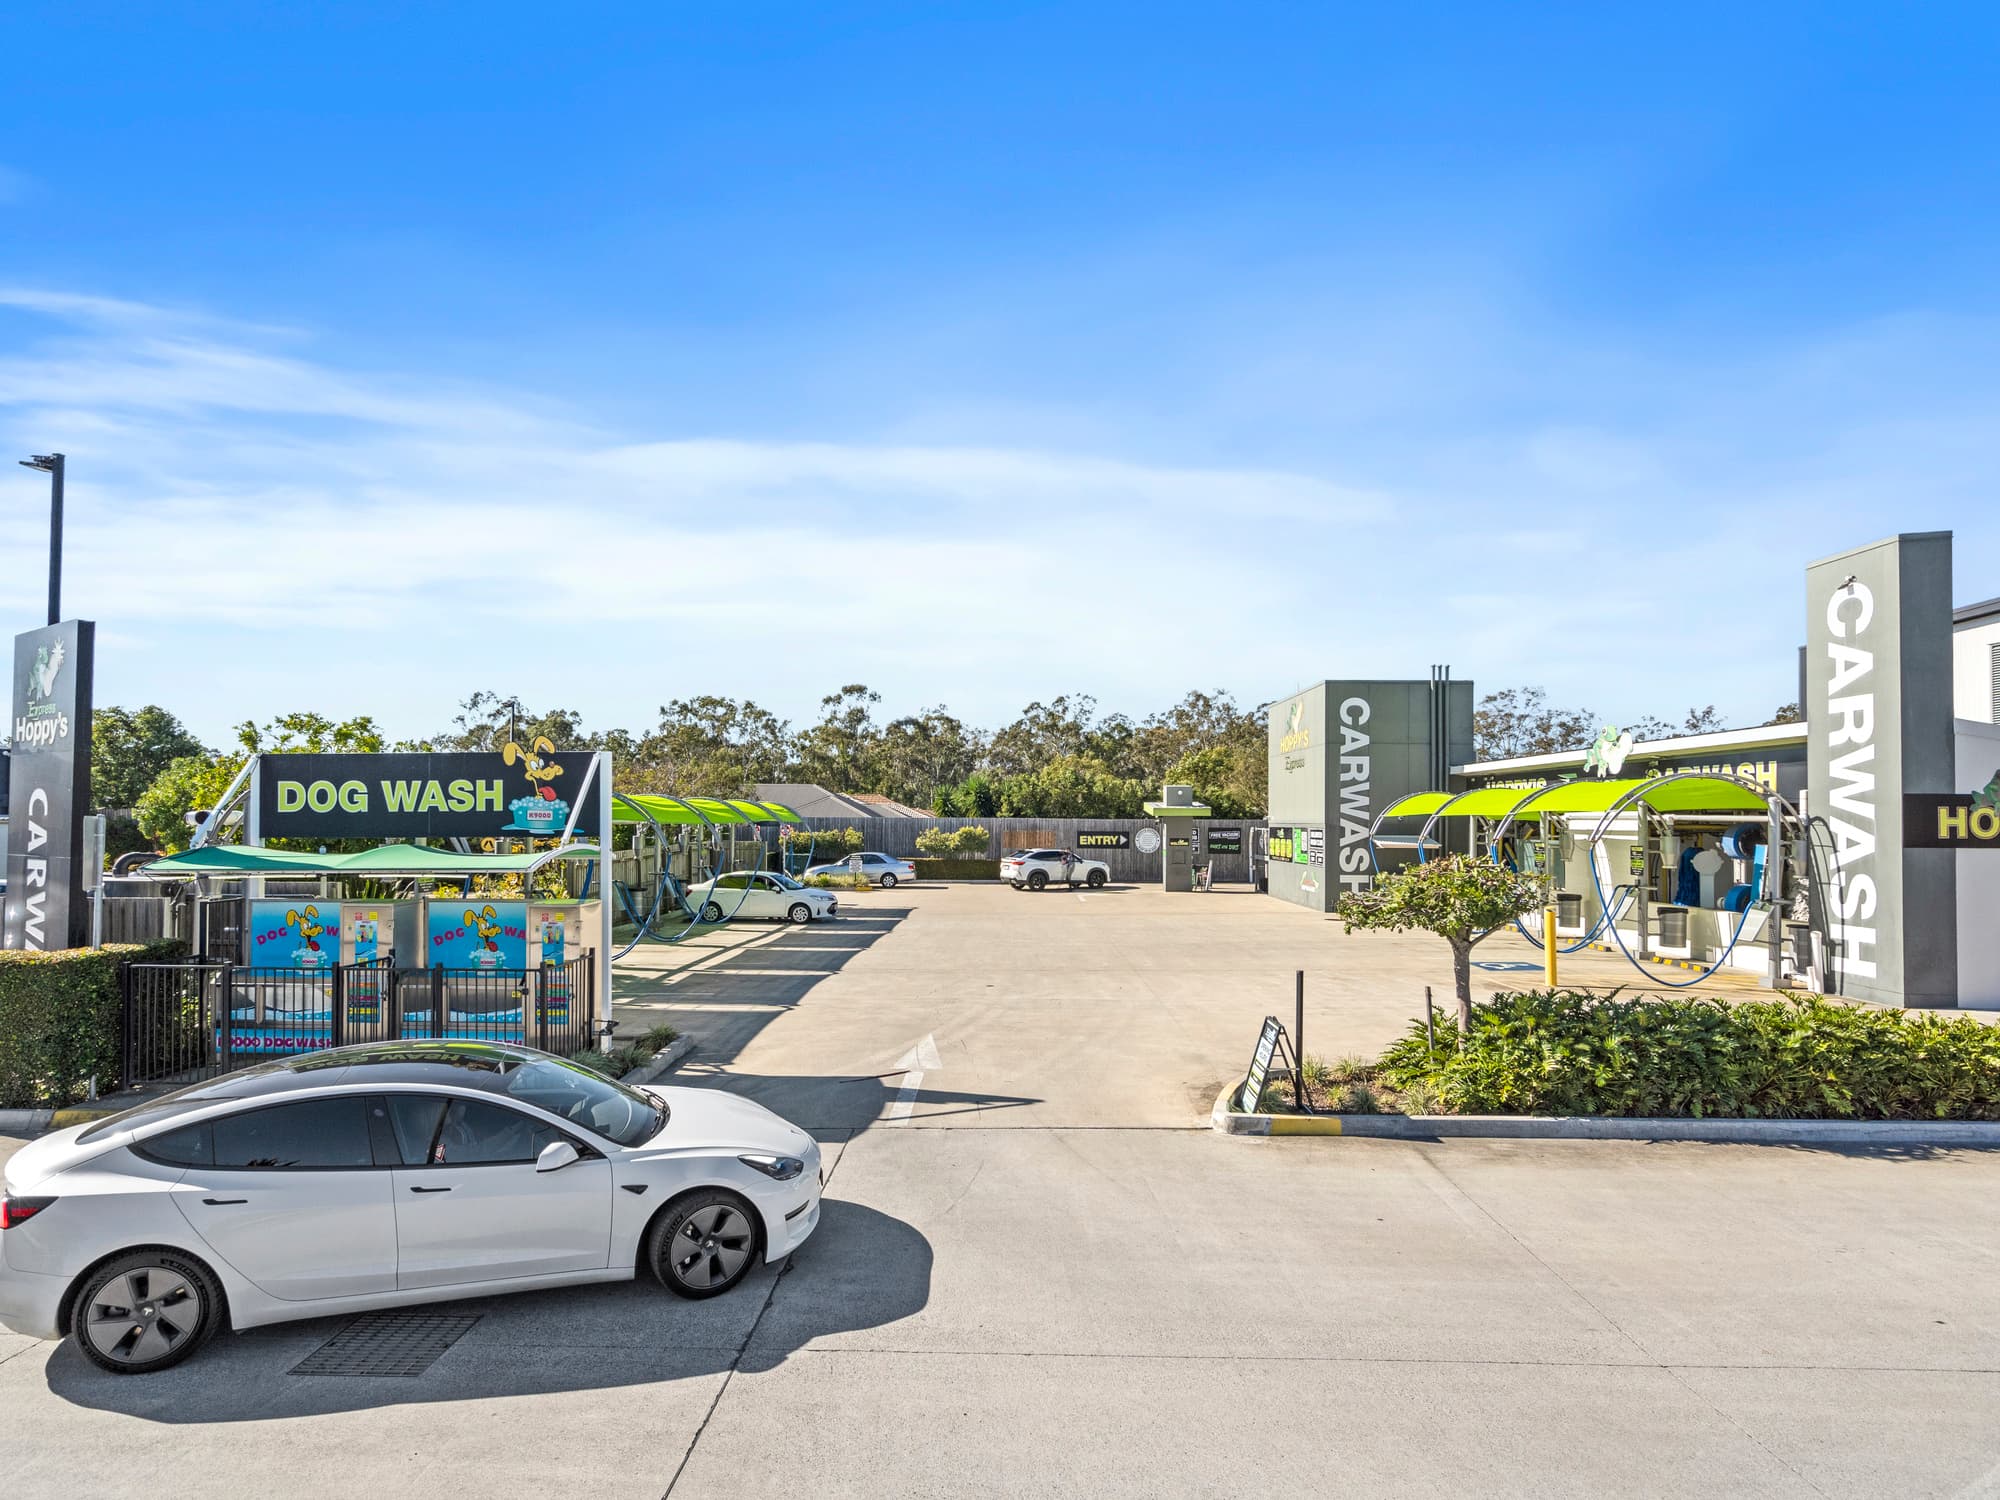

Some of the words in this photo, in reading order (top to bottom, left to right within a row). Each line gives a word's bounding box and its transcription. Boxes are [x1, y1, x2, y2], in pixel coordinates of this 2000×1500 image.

[16, 712, 68, 747] Hoppy's
[277, 780, 369, 813] DOG
[381, 779, 504, 813] WASH
[1827, 582, 1878, 979] CARWASH
[1079, 835, 1119, 846] ENTRY
[25, 788, 49, 950] CARW
[256, 927, 288, 945] DOG
[433, 927, 465, 946] DOG
